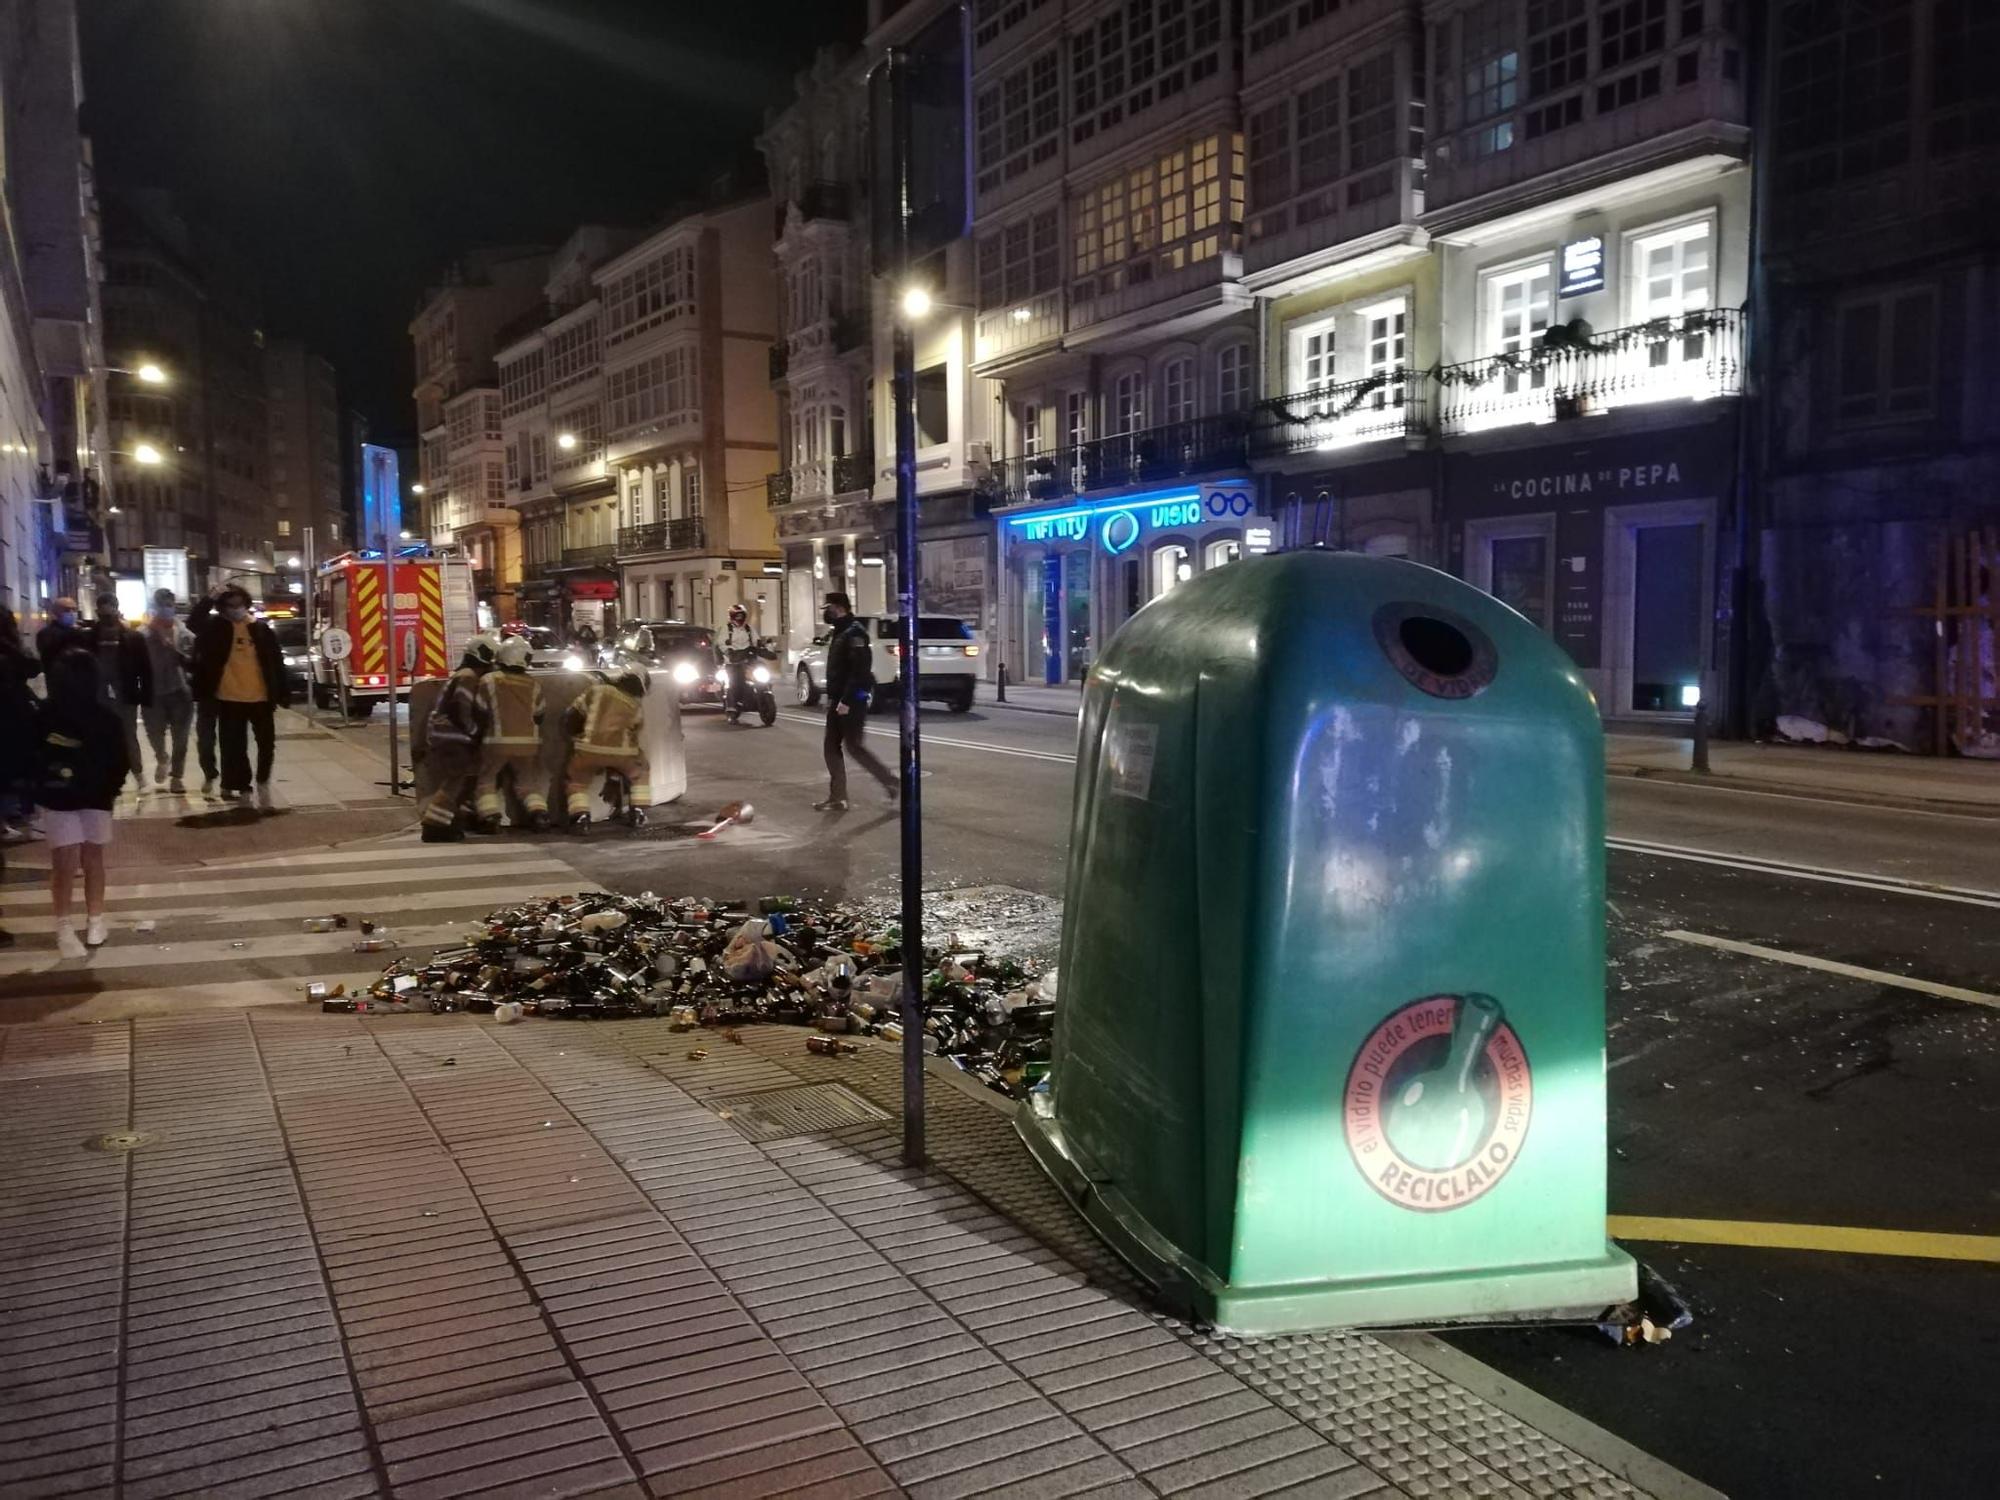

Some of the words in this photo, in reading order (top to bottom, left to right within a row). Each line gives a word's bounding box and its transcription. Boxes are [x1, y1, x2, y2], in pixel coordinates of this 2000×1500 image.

[1492, 482, 1506, 493] LA
[1512, 473, 1593, 500] COCINA
[1598, 470, 1613, 481] DE
[1618, 463, 1680, 487] PEPA
[1151, 502, 1201, 528] VISIO
[1407, 1007, 1456, 1033] tener
[1363, 1024, 1406, 1078] puede
[1493, 1035, 1524, 1092] muchas
[1350, 1080, 1373, 1135] vidrio
[1503, 1093, 1527, 1133] vidas
[1355, 1136, 1378, 1154] el
[1379, 1141, 1509, 1203] RECICLALO
